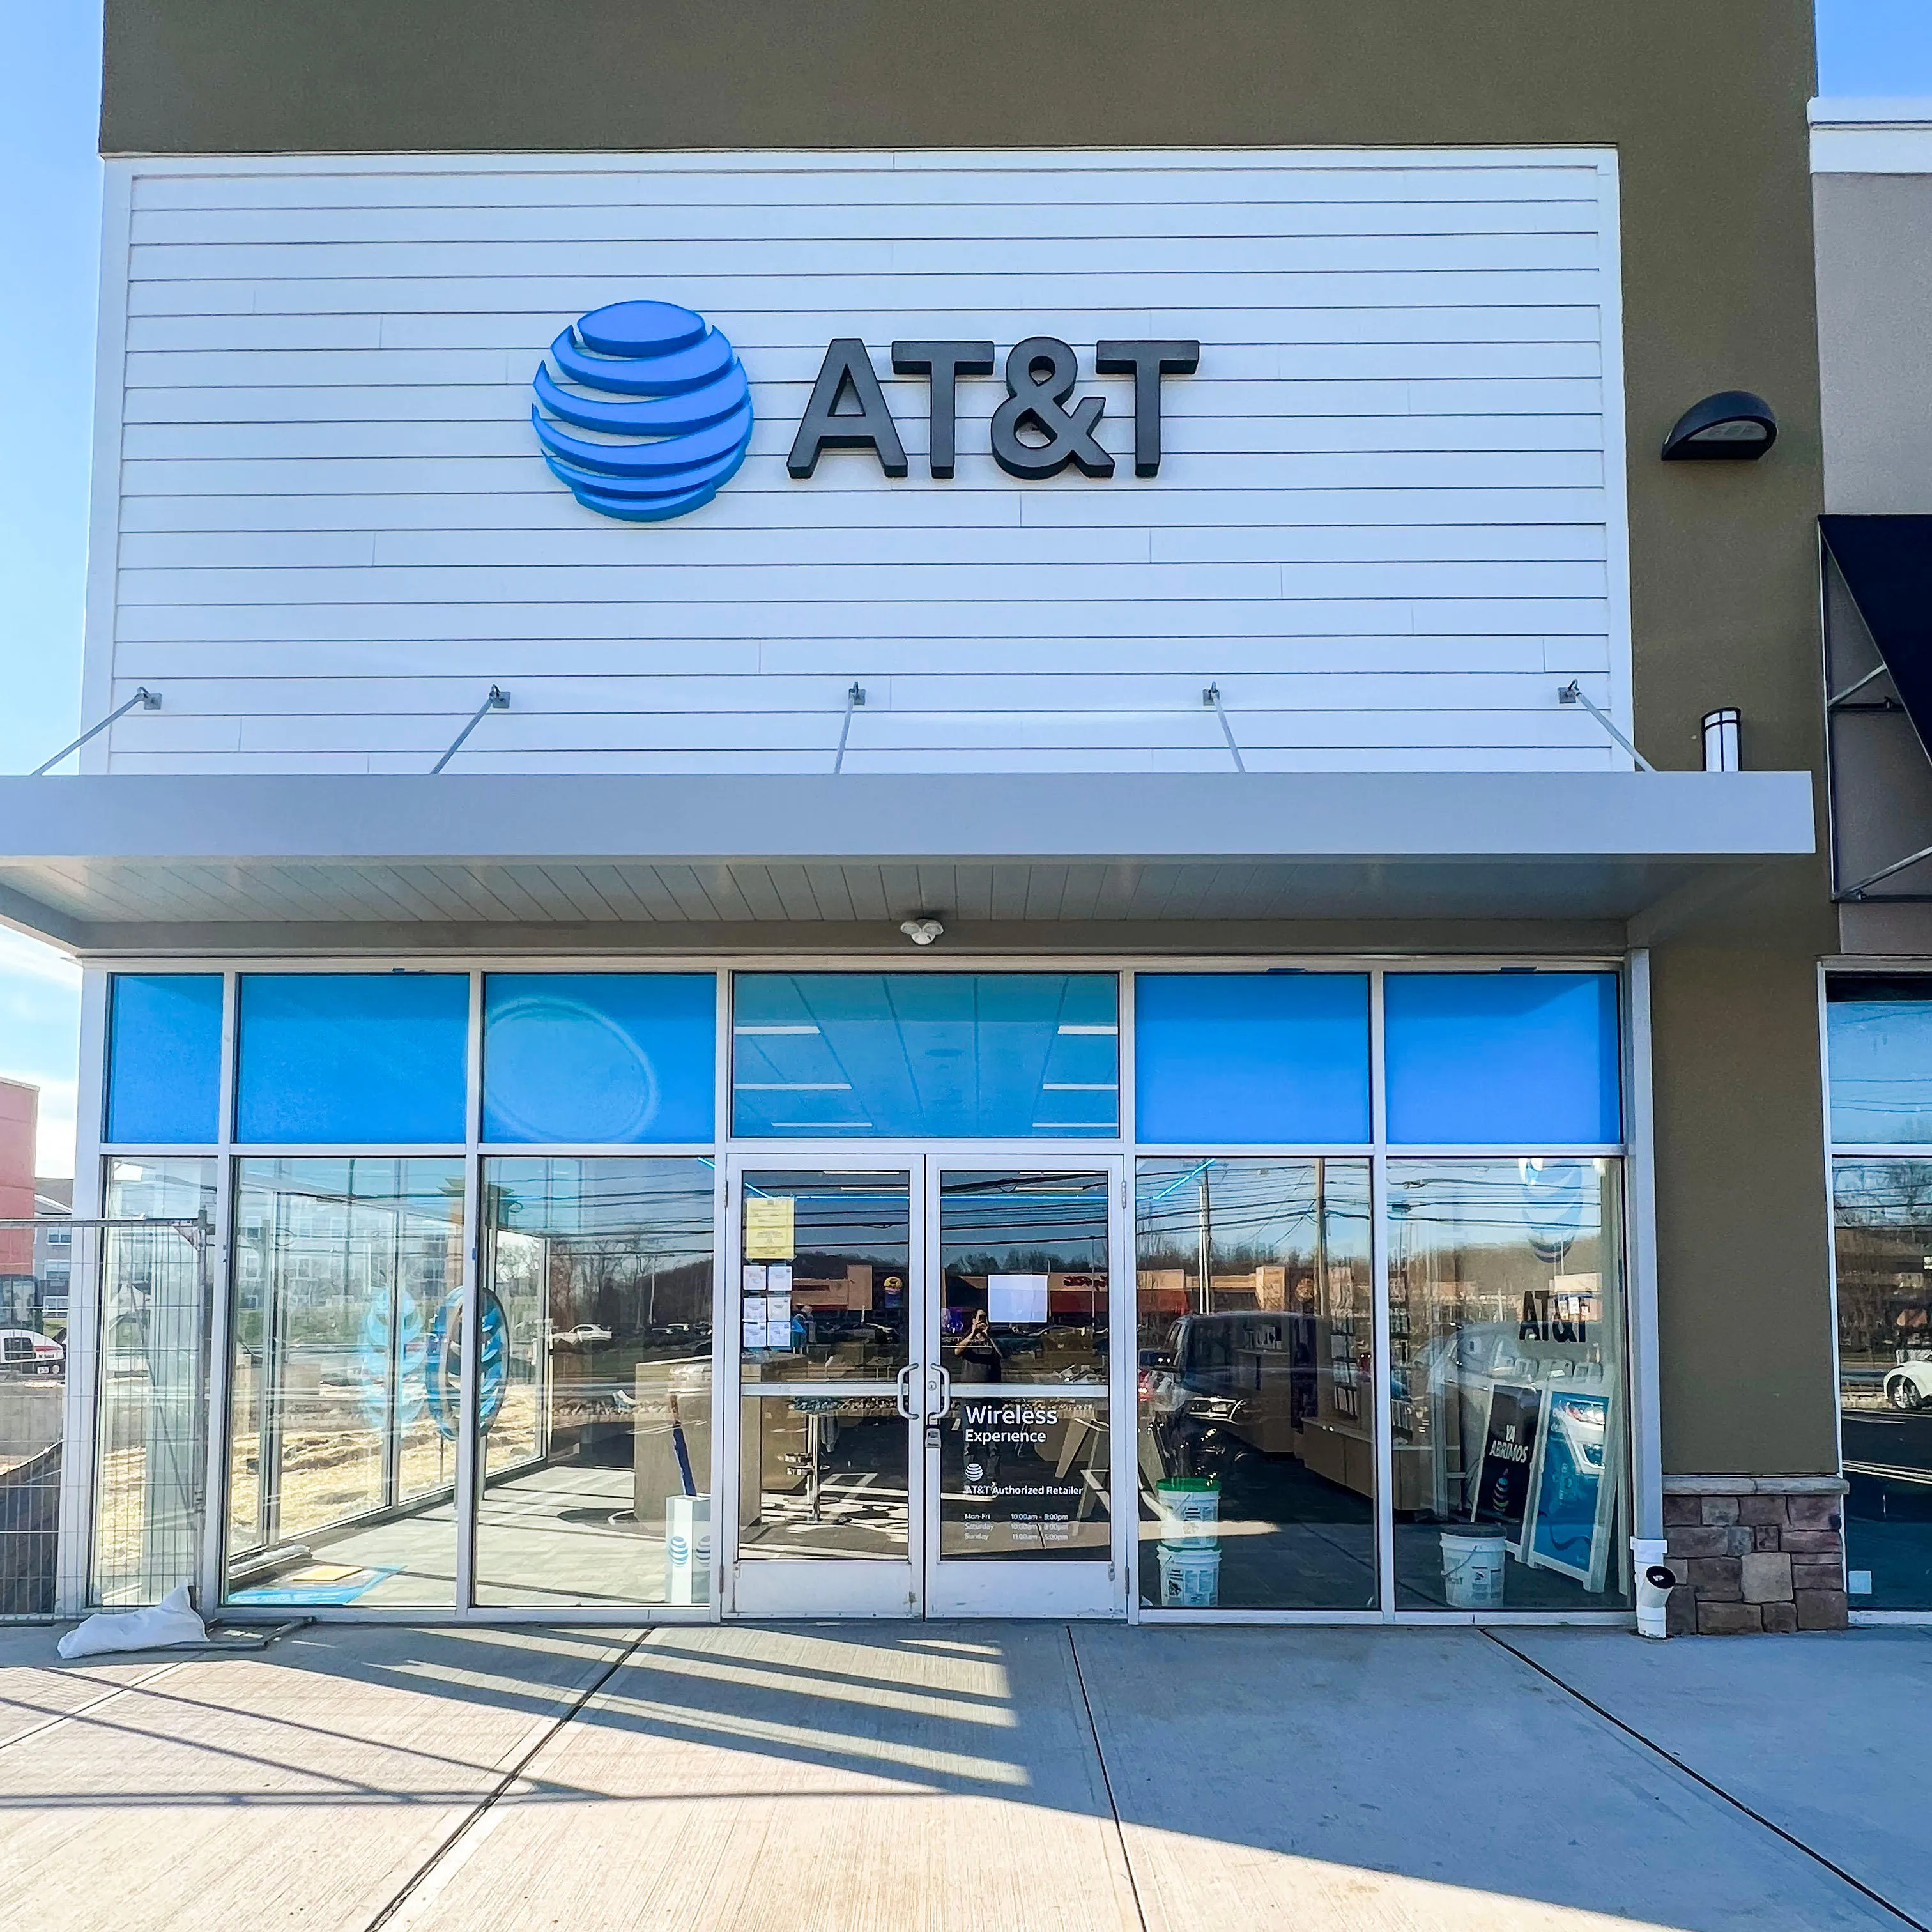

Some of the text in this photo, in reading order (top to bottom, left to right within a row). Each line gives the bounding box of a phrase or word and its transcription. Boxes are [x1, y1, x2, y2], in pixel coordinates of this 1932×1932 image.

[786, 336, 1200, 480] AT&T
[965, 1405, 1058, 1425] Wireless
[965, 1429, 1046, 1445] Experience
[1489, 1440, 1529, 1463] ABRIMOS
[963, 1485, 1083, 1495] AT&T Authorized Retailer
[965, 1533, 989, 1541] Sunday
